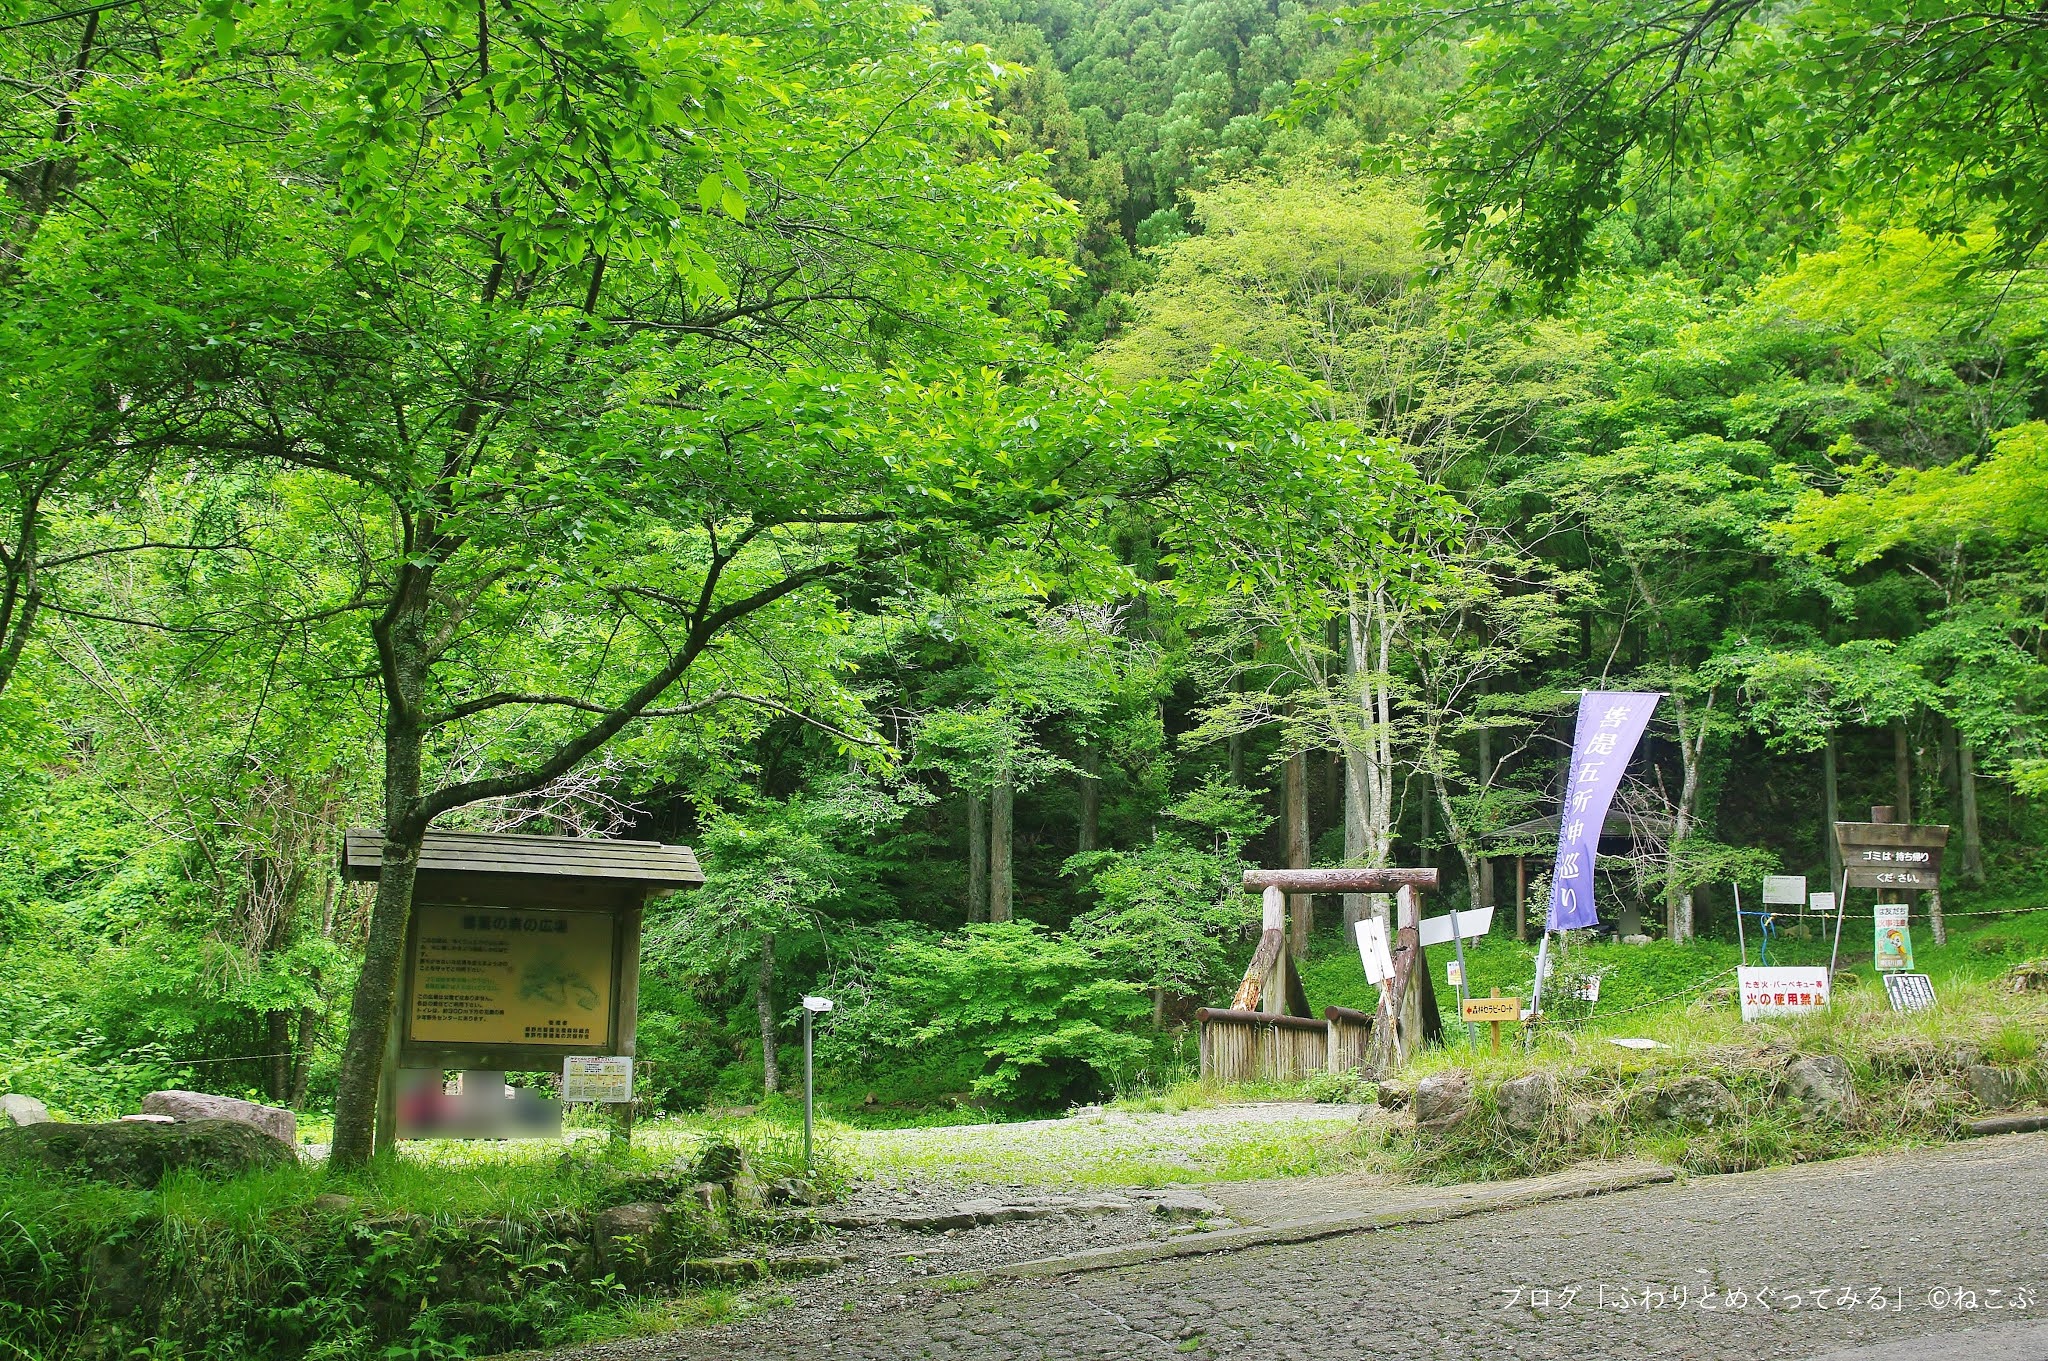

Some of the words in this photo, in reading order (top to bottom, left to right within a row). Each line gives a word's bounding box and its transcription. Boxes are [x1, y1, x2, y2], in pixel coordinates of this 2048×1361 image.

[1560, 706, 1631, 914] 菩提五所神巡り
[1747, 992, 1825, 1006] 火の使用禁止
[1472, 1003, 1513, 1014] 森林セラピーロード
